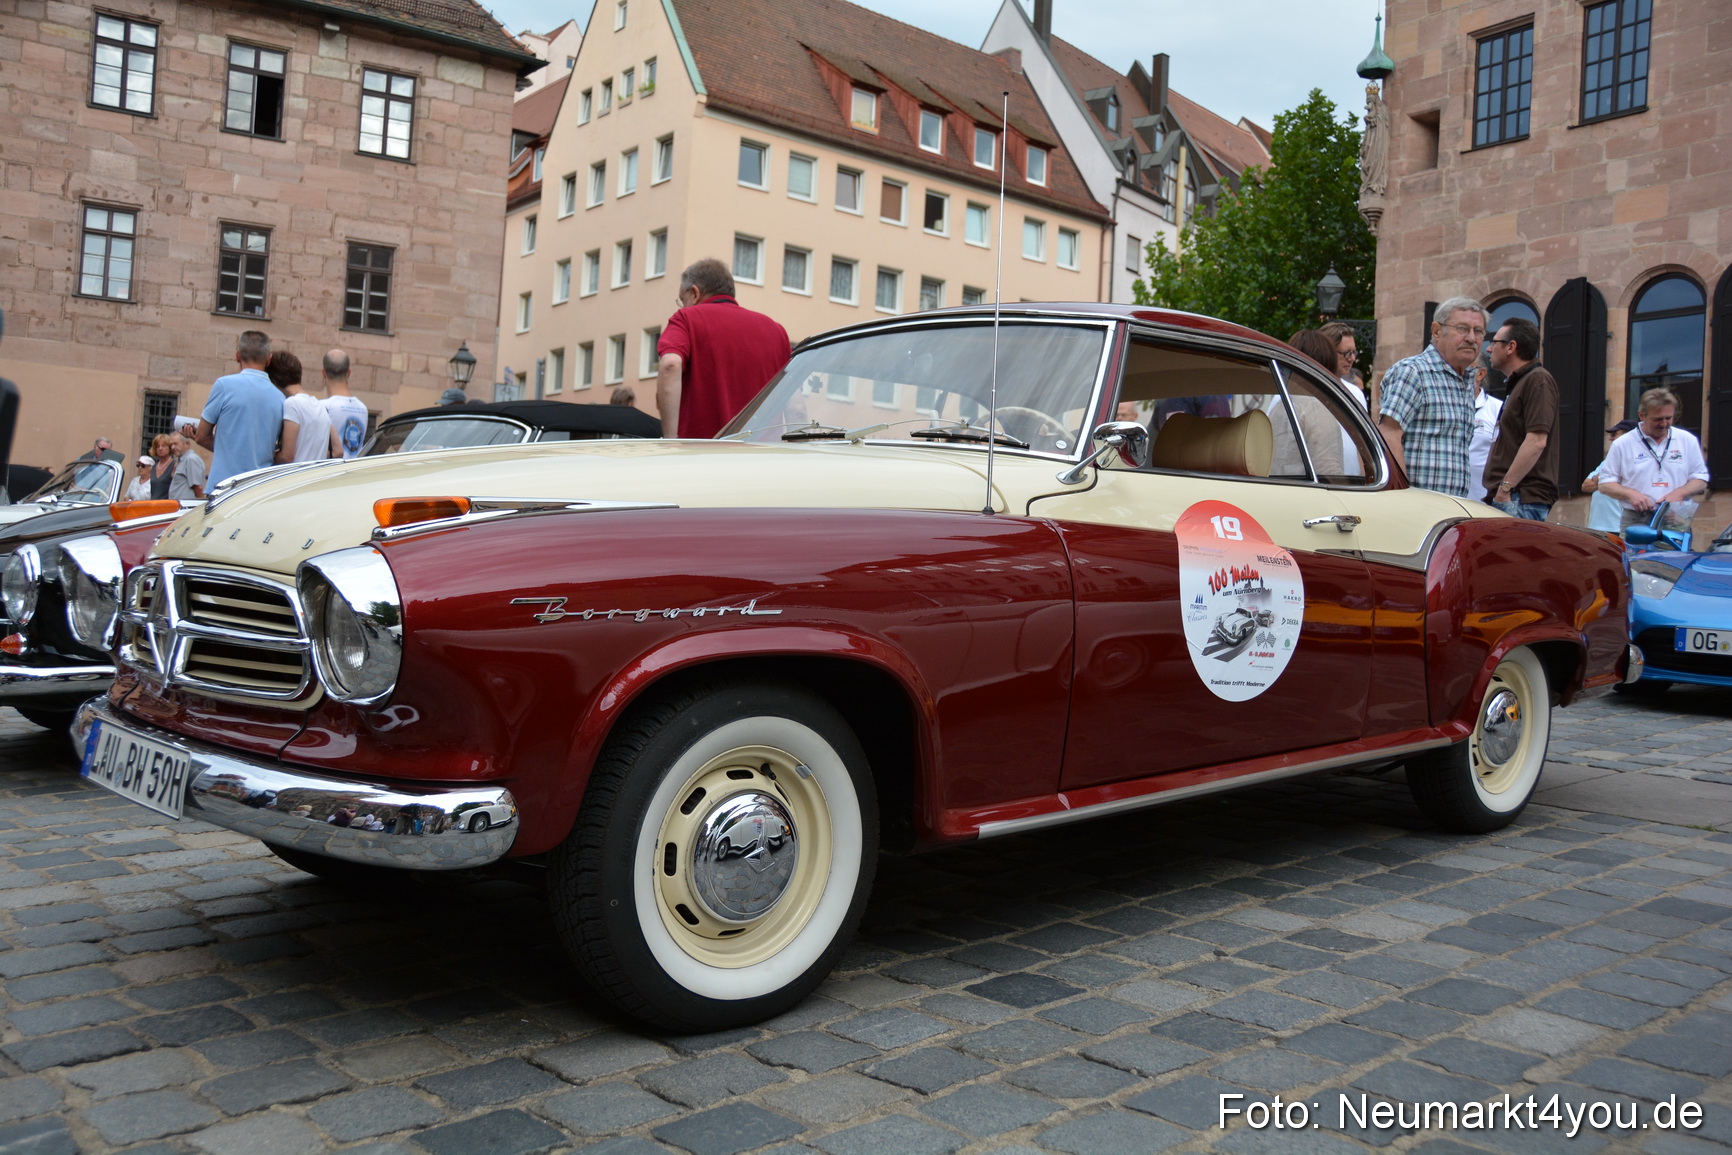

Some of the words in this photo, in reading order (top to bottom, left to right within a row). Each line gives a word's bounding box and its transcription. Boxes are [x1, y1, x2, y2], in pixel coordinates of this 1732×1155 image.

[1210, 515, 1244, 541] 19
[1256, 555, 1292, 567] MEILENSTEIN
[1208, 567, 1229, 596] 100
[1230, 563, 1260, 587] Meilen
[1234, 586, 1262, 596] Nürnberg
[510, 597, 783, 623] Borgward
[1693, 631, 1718, 651] OG
[147, 751, 186, 810] 59H
